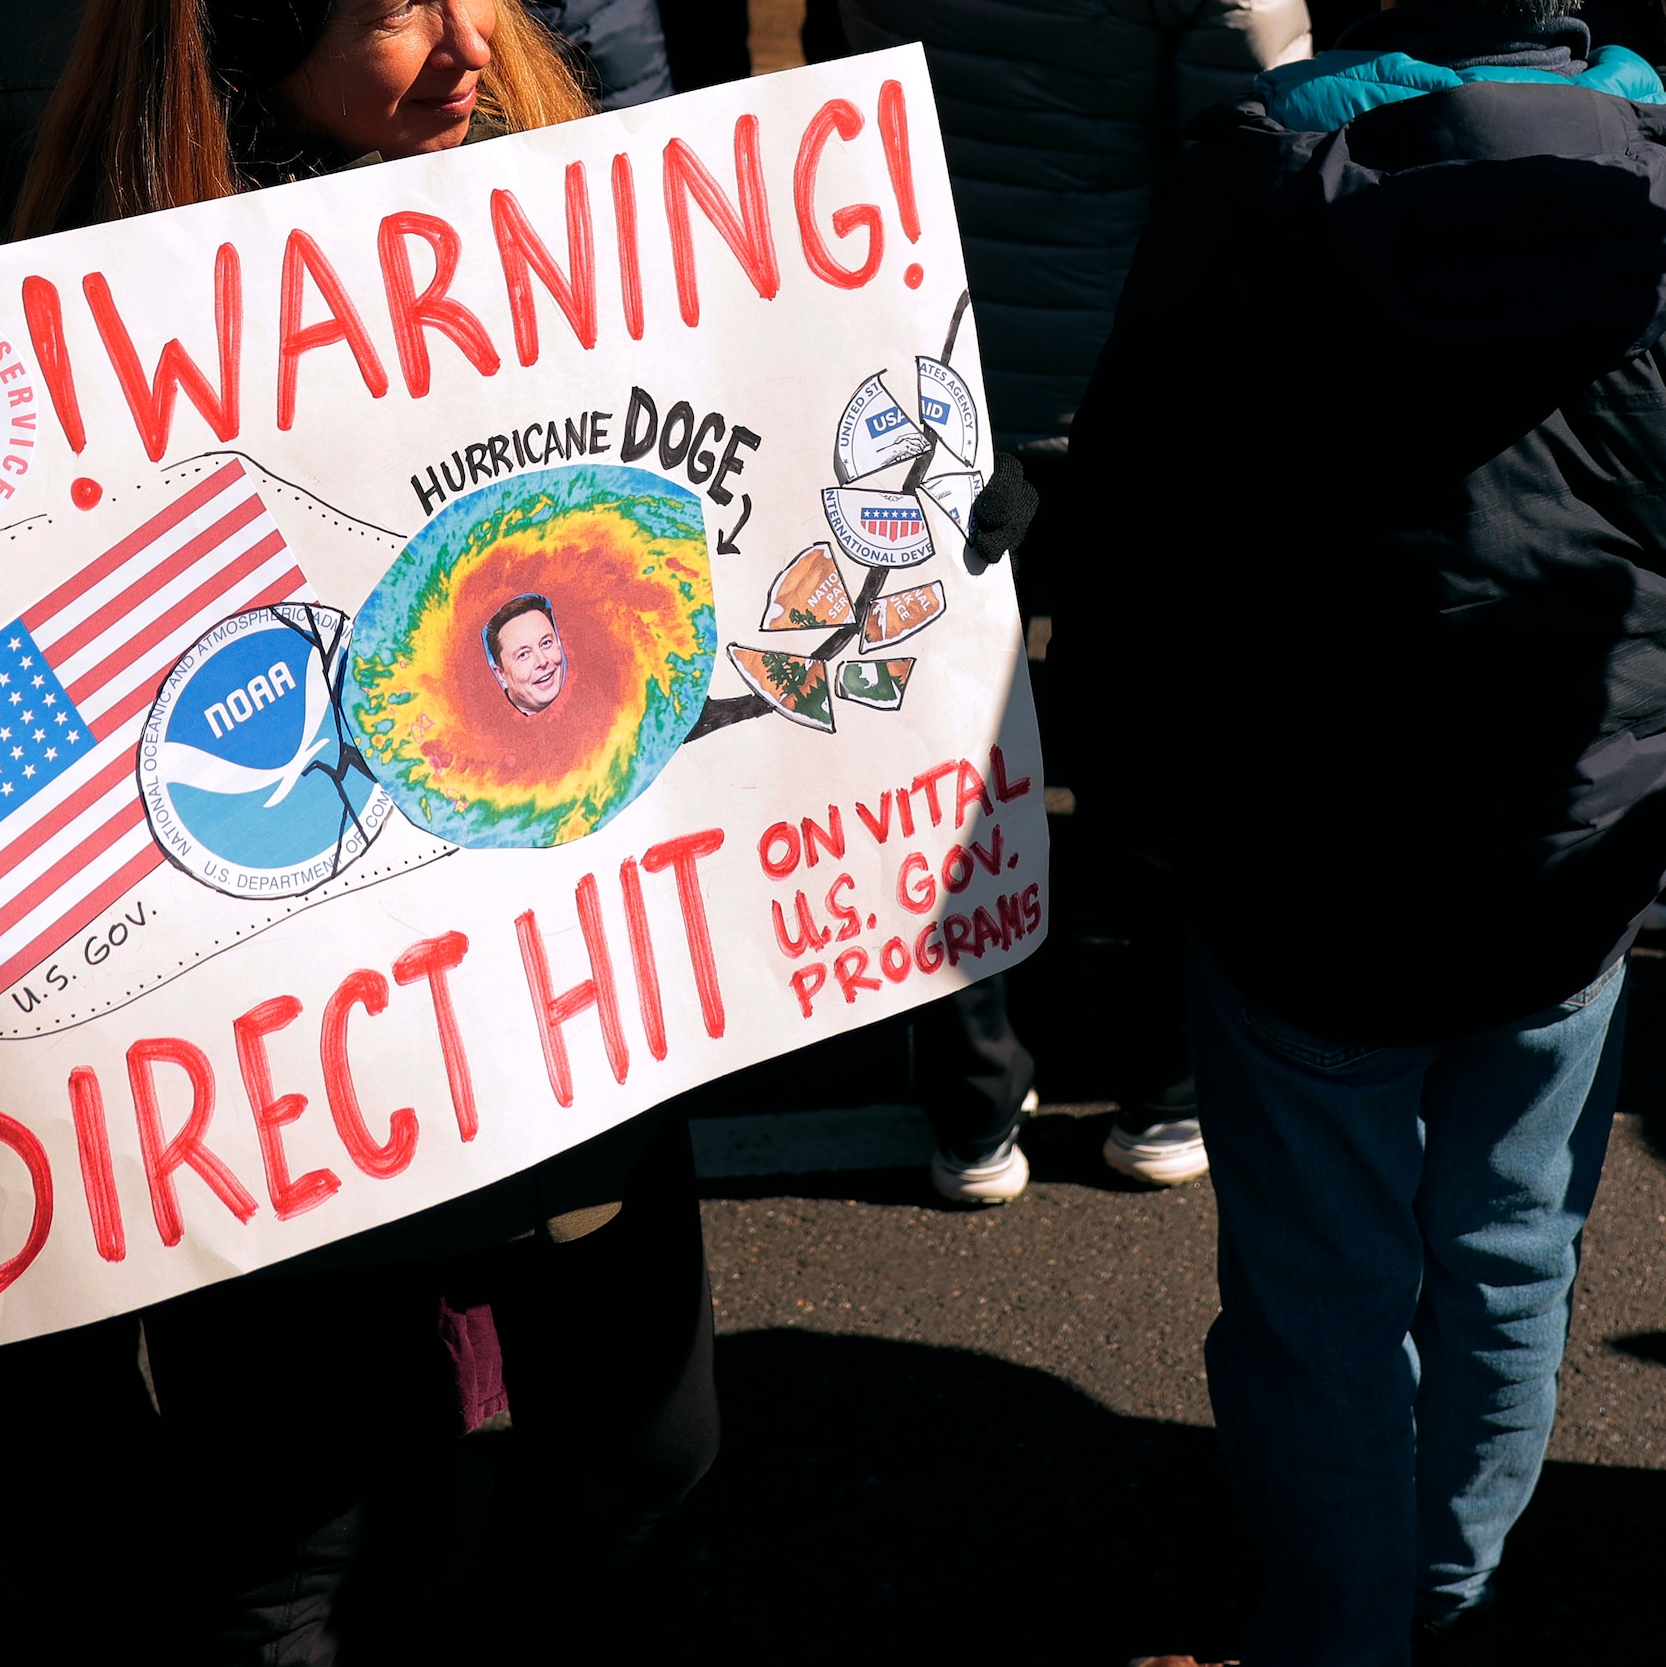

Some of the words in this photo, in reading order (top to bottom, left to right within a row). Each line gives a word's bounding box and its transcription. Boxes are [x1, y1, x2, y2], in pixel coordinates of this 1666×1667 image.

[840, 397, 865, 447] UNITED
[947, 380, 973, 429] AGENCY
[411, 411, 613, 515] HURRICANE
[621, 386, 762, 506] DOGE
[825, 490, 897, 563] NTERNATIONAL
[168, 655, 196, 688] AND
[197, 606, 307, 656] ATMOSPHERIC
[144, 689, 172, 772] OCEANIC
[203, 661, 297, 739] NOAA
[144, 775, 191, 856] NATIONAL
[758, 803, 845, 880] ON
[856, 744, 1031, 845] VITAL
[204, 861, 231, 884] U.S.
[345, 830, 363, 854] OF
[771, 873, 877, 958] U.S.
[896, 825, 1019, 913] GOV.
[12, 964, 77, 1013] U.S.
[84, 901, 156, 965] GOV.
[514, 828, 724, 1108] HIT
[790, 883, 1042, 1019] PROGRAMS
